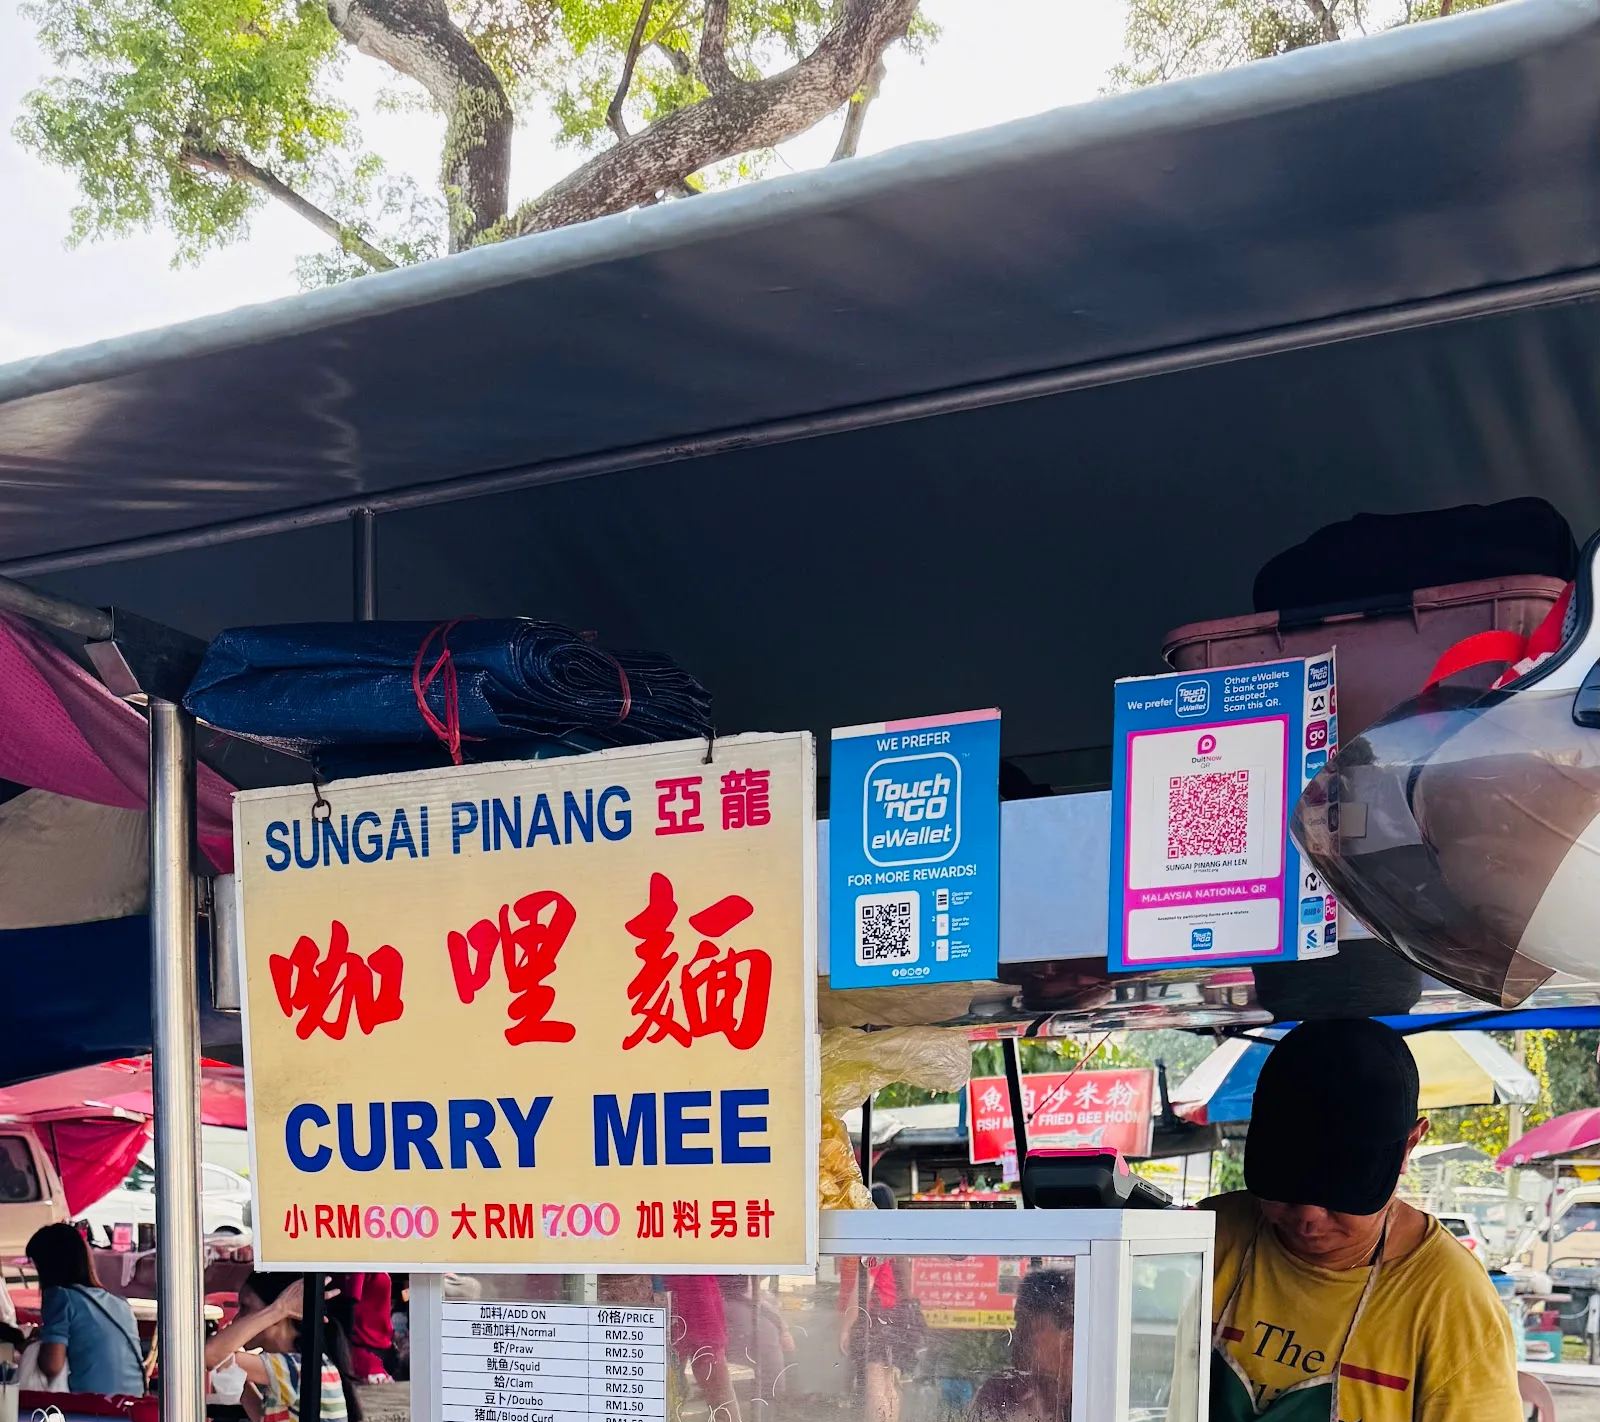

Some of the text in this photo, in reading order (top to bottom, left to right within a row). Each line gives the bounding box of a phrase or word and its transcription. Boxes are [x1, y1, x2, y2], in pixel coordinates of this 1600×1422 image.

[1224, 671, 1289, 685] Other eWallets
[1179, 687, 1206, 697] Touch
[1224, 681, 1279, 694] & bank apps
[1224, 691, 1268, 703] accepted.
[1127, 698, 1173, 711] We prefer
[1178, 703, 1206, 713] eWallet
[1223, 698, 1281, 712] Scan this QR.
[876, 731, 951, 751] WE PREFER
[1309, 729, 1325, 746] go
[1191, 755, 1222, 764] DuitNow
[872, 773, 951, 802] Touch
[265, 785, 632, 872] SUNGAI PINANG
[871, 824, 952, 849] eWallet
[1165, 863, 1192, 872] SUNGAI
[1194, 860, 1221, 869] PINANG
[1234, 858, 1247, 866] LEN
[847, 864, 977, 887] FOR MORE REWARDS!
[1142, 884, 1267, 903] MALAYSIA NATIONAL QR
[269, 872, 773, 1051] 咖哩麵
[976, 1117, 1000, 1132] FISH
[1038, 1112, 1074, 1126] FRIED
[1076, 1110, 1102, 1125] BEE
[284, 1088, 771, 1173] CURRY MEE
[636, 1198, 775, 1240] 加料另計
[480, 1306, 546, 1321] 加料/ADD ON
[597, 1310, 654, 1324] 价格/PRICE
[471, 1323, 556, 1338] 普通加料/Normal
[605, 1330, 644, 1342] RM2.50
[493, 1341, 534, 1355] 虾/Praw
[605, 1348, 644, 1359] RM2.50
[1252, 1320, 1325, 1374] The
[486, 1358, 541, 1372] 鱿鱼/Squid
[605, 1365, 644, 1376] RM2.50
[605, 1383, 644, 1394] RM2.50
[605, 1400, 644, 1411] RM1.50
[475, 1408, 529, 1422] 猪血/Blood
